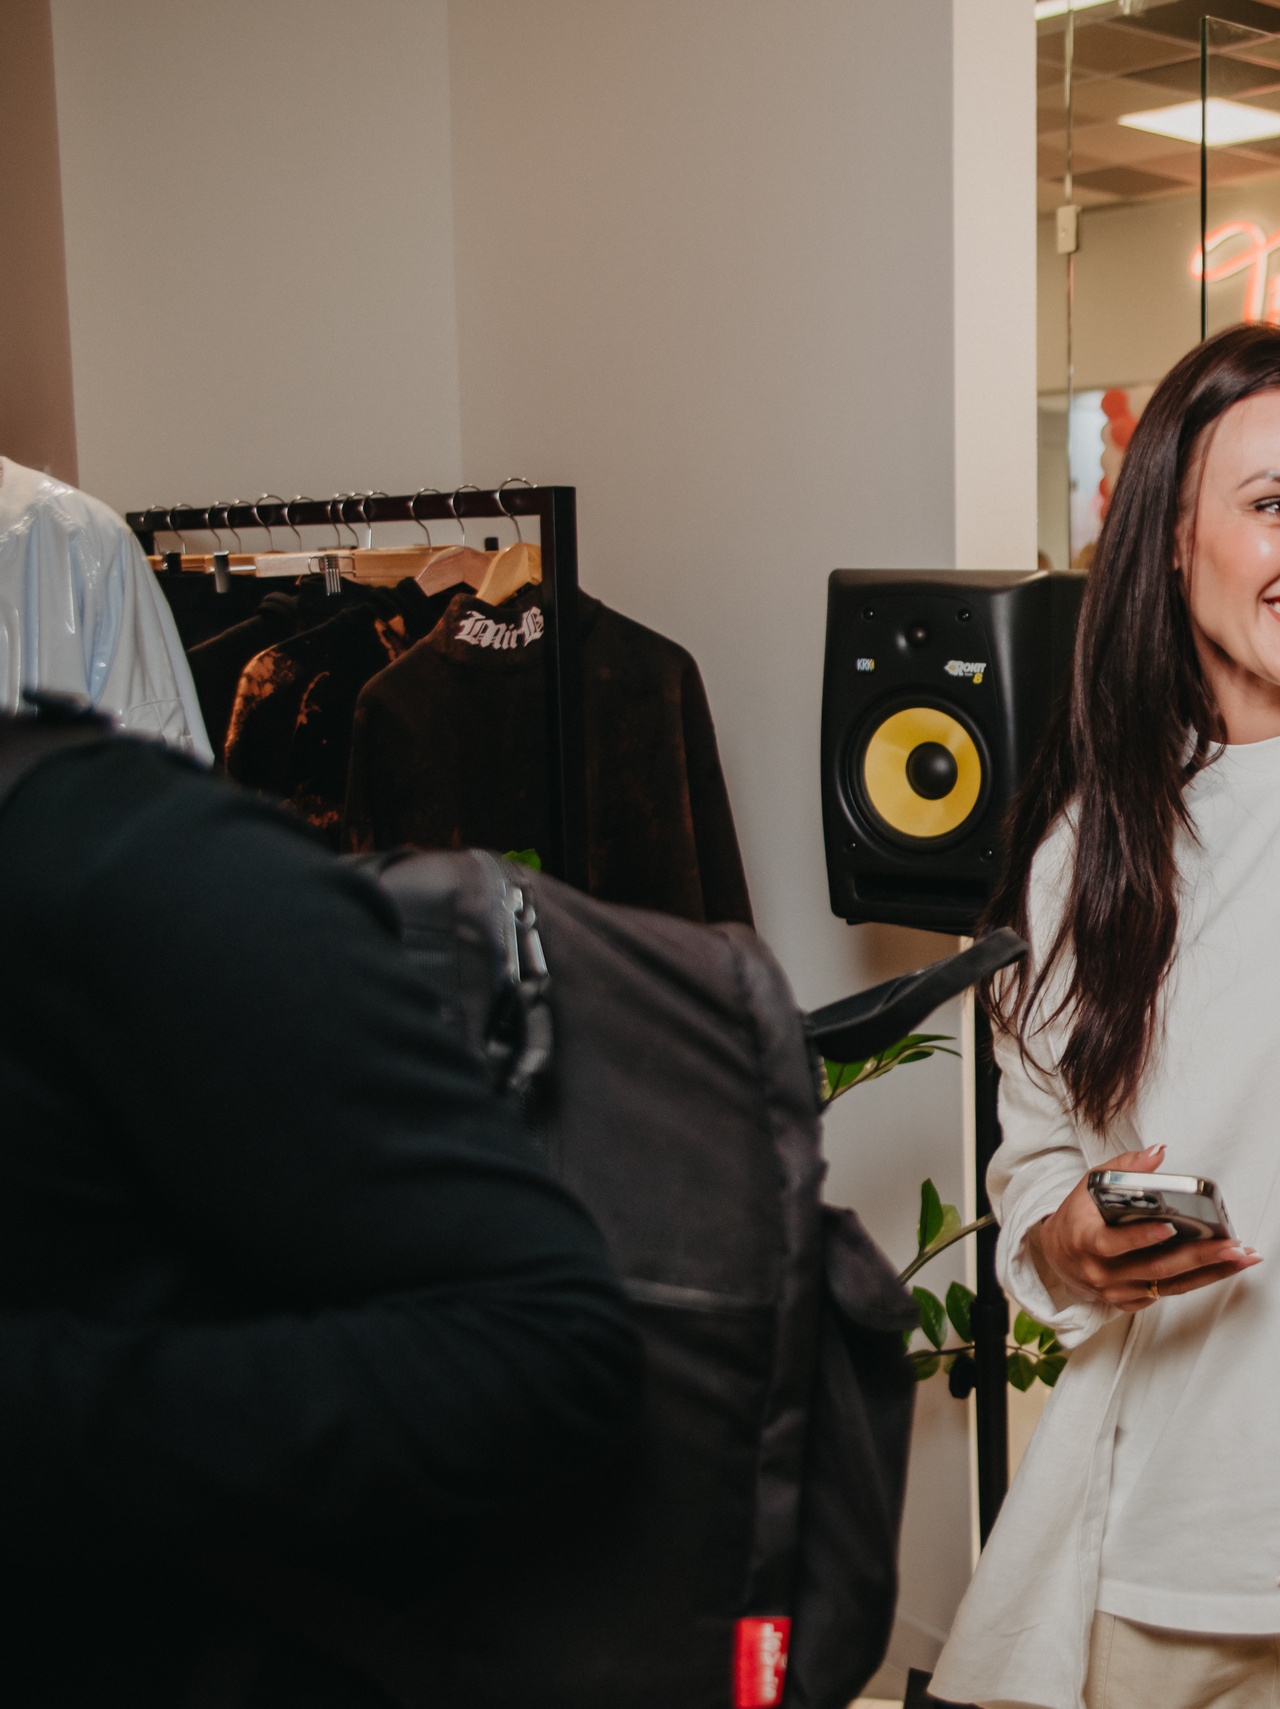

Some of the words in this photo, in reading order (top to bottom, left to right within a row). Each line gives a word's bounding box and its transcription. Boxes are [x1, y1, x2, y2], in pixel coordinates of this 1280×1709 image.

[857, 658, 871, 671] KRK
[954, 660, 986, 676] ROKIT
[972, 673, 983, 684] 8
